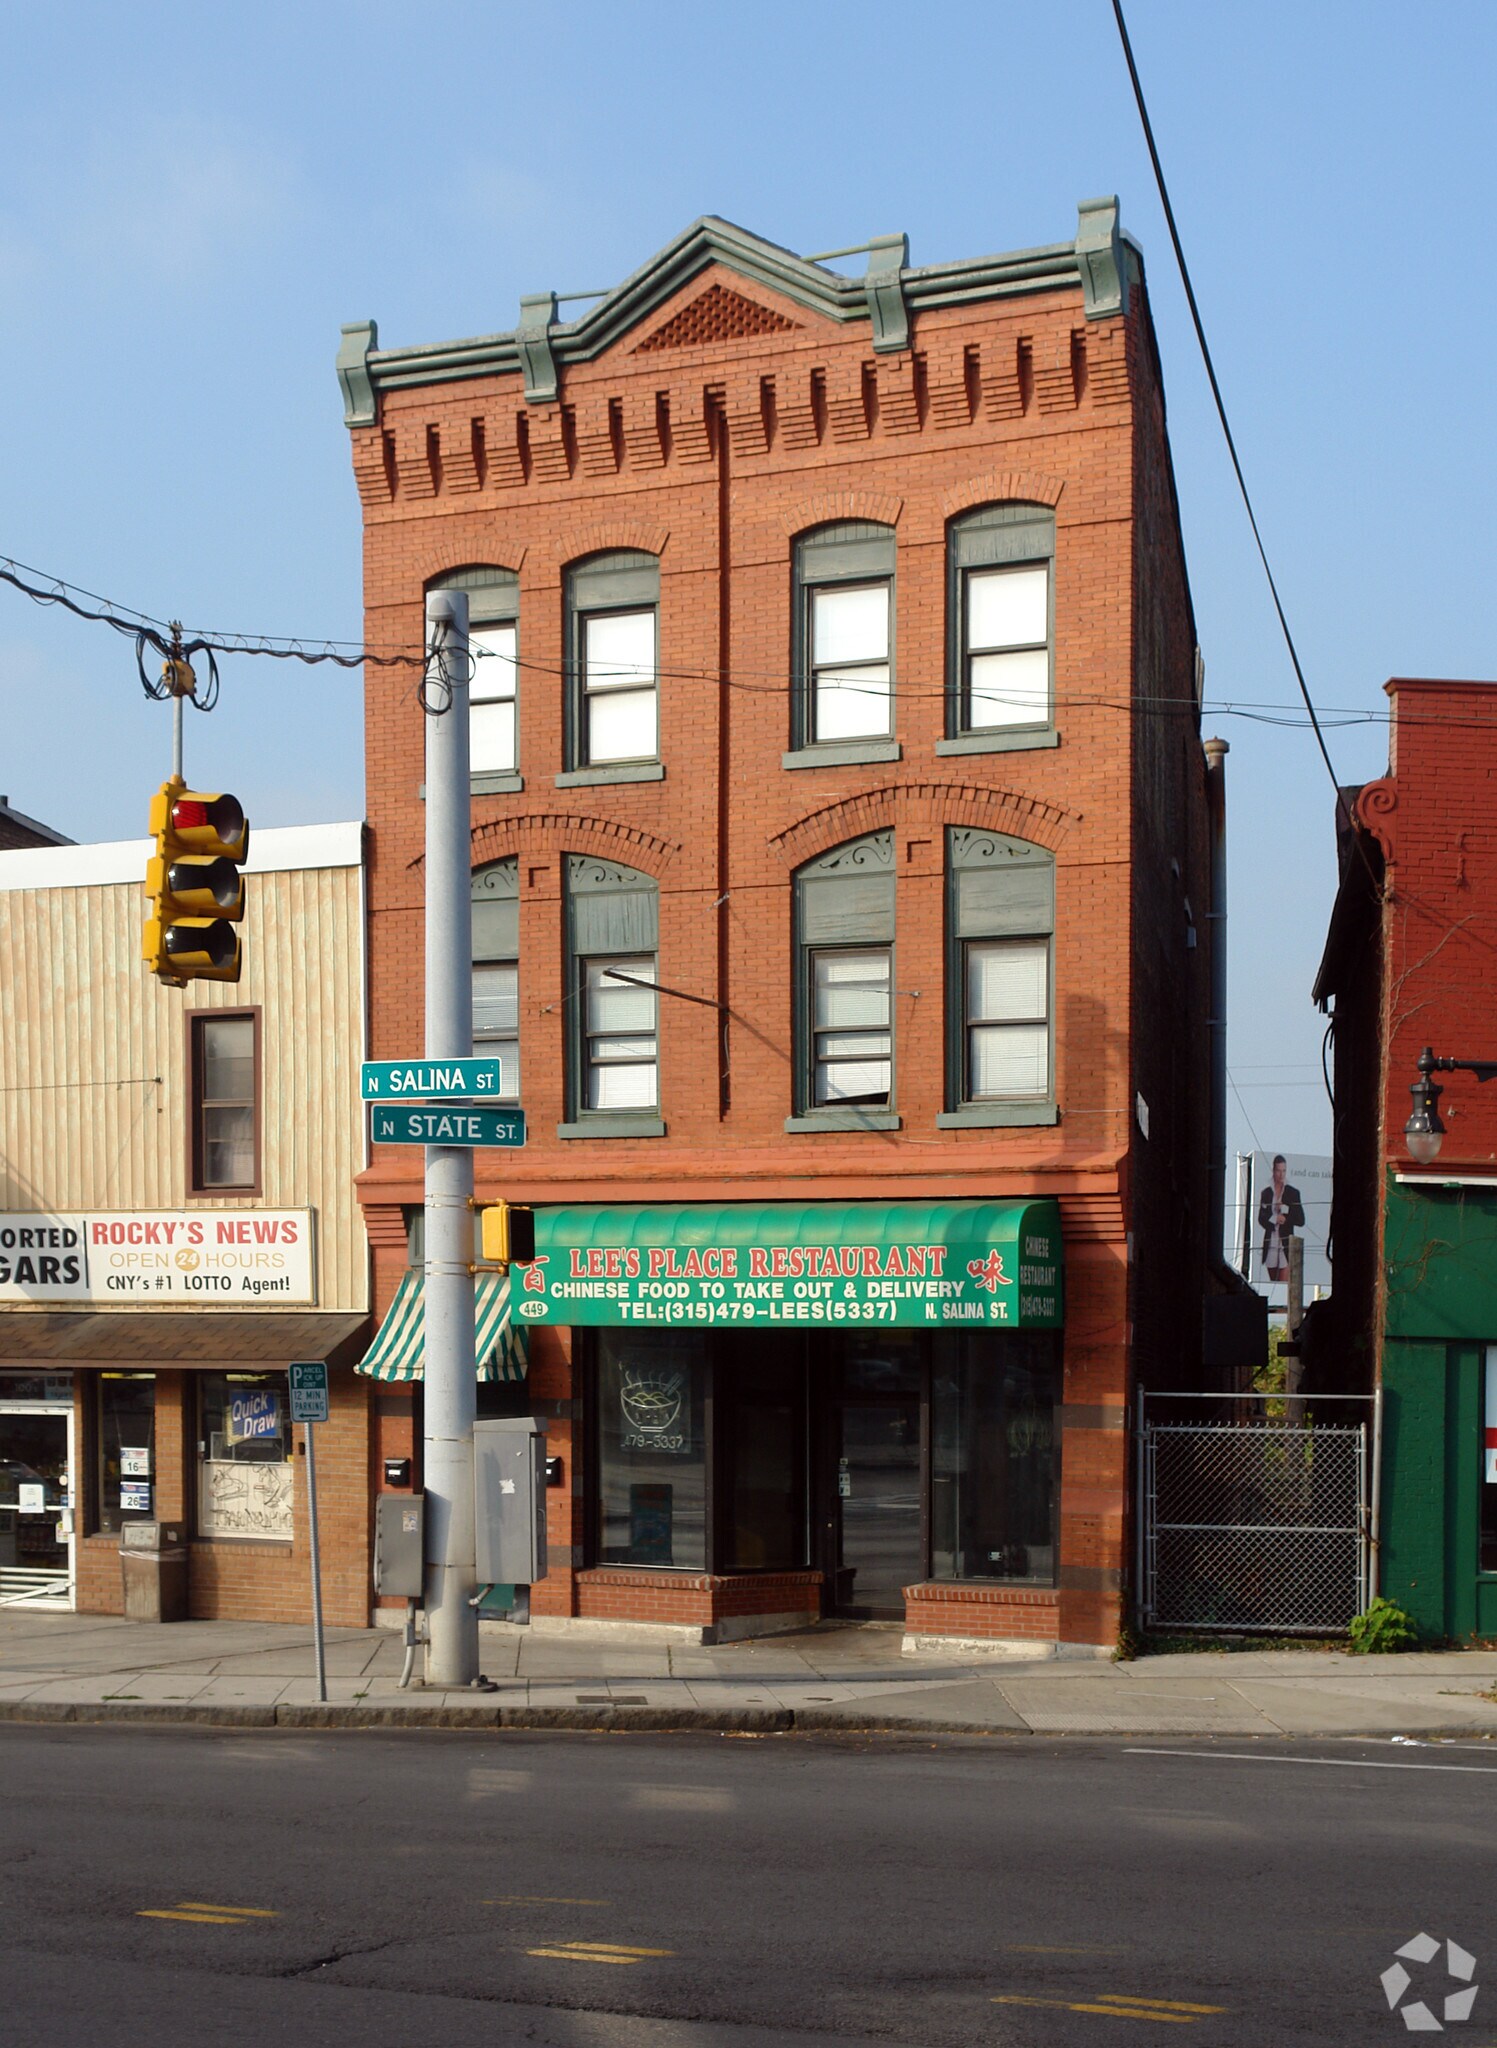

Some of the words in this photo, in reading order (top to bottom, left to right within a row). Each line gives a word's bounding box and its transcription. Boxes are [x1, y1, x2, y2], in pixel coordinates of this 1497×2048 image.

[368, 1077, 379, 1092] N
[389, 1068, 466, 1092] SALINA
[382, 1121, 394, 1135] N
[407, 1115, 482, 1138] STATE
[1, 1227, 78, 1249] ORTED
[92, 1221, 204, 1245] ROCKY'S
[216, 1220, 298, 1244] NEWS
[109, 1252, 169, 1268] OPEN
[178, 1252, 198, 1266] 24
[206, 1252, 285, 1268] HOURS
[569, 1248, 641, 1279] LEE'S
[647, 1247, 737, 1279] PLACE
[749, 1245, 948, 1278] RESTAURANT
[106, 1275, 149, 1290] CNY's
[155, 1275, 172, 1290] #1
[184, 1275, 232, 1290] LOTTO
[242, 1276, 291, 1295] Agent!
[1020, 1265, 1056, 1286] RESTAURANT
[550, 1282, 630, 1299] CHINESE
[638, 1282, 690, 1299] FOOD
[699, 1282, 725, 1299] TO
[733, 1282, 785, 1299] TAKE
[793, 1282, 834, 1299] OUT
[843, 1282, 858, 1299] &
[867, 1281, 966, 1298] DELIVERY
[523, 1303, 544, 1316] 449
[618, 1301, 898, 1321] TEL:(315)479-LEES(5337)
[925, 1303, 938, 1319] N.
[942, 1303, 985, 1319] SALINA
[990, 1302, 1009, 1319] ST.
[293, 1366, 303, 1388] P
[294, 1391, 302, 1401] 12
[232, 1393, 268, 1422] Quick
[294, 1402, 324, 1412] PARKING
[243, 1411, 276, 1438] Draw
[624, 1434, 683, 1449] 479-5337
[127, 1462, 139, 1472] 16
[127, 1497, 139, 1506] 26
